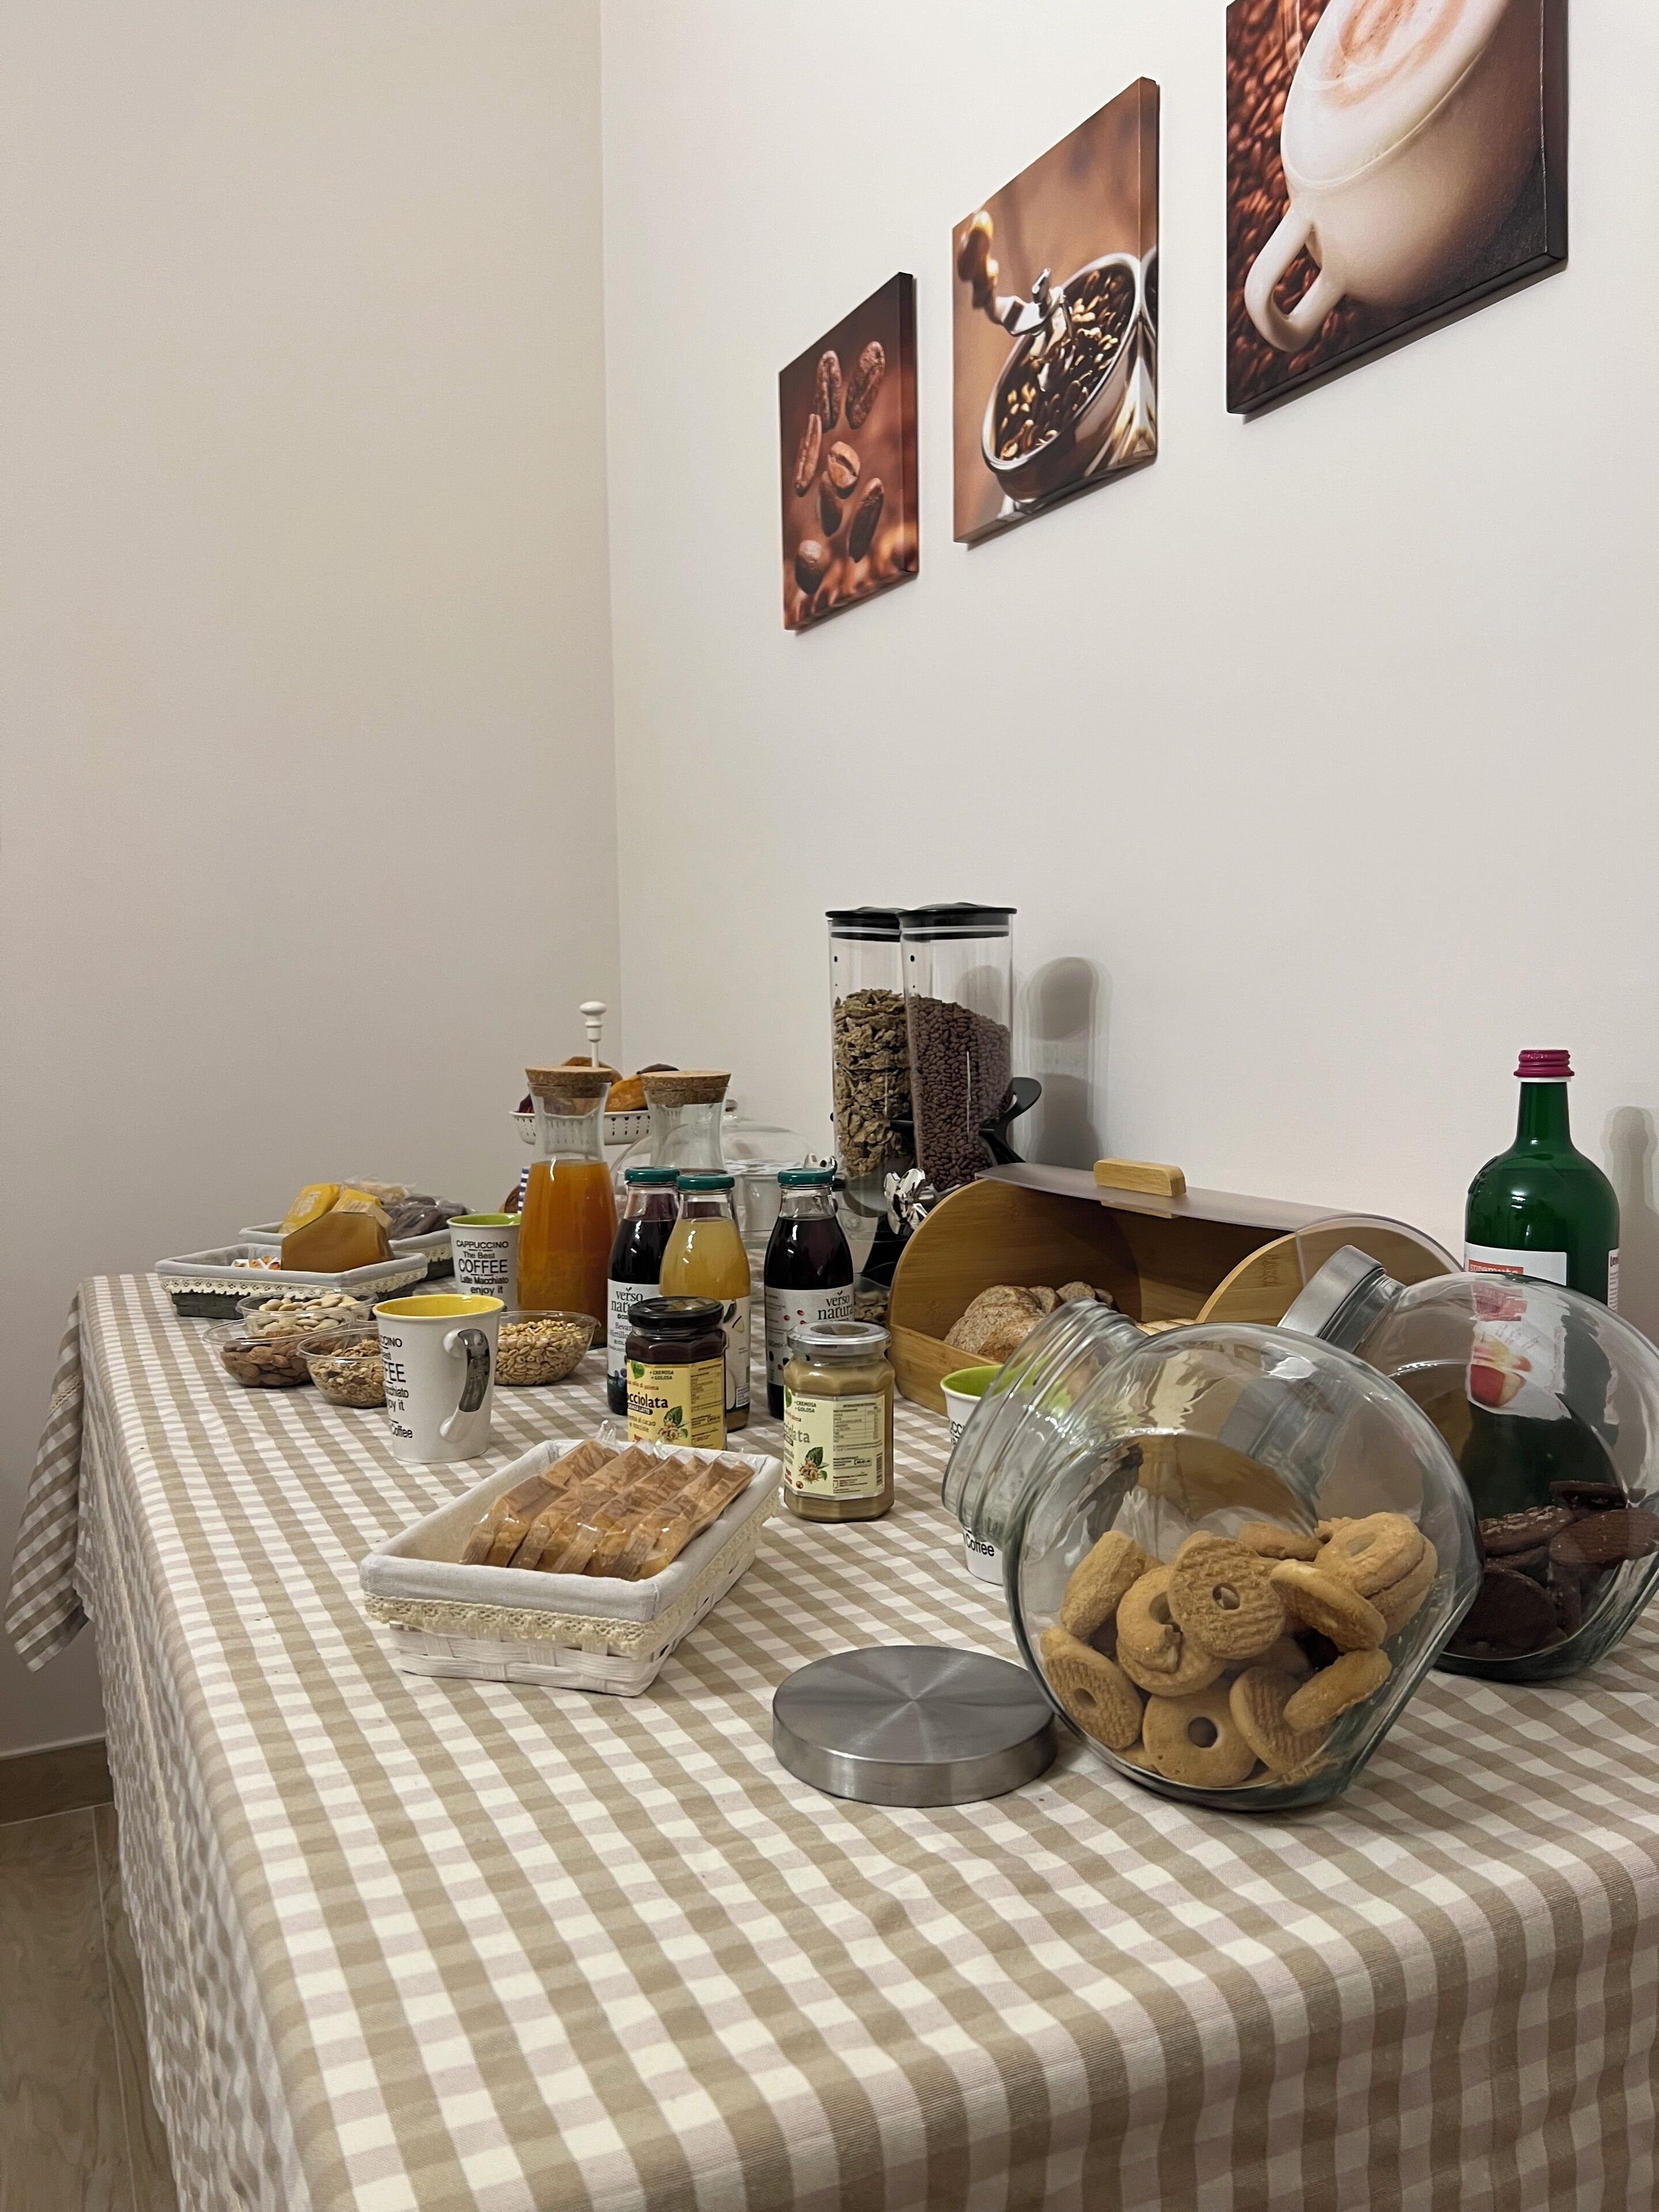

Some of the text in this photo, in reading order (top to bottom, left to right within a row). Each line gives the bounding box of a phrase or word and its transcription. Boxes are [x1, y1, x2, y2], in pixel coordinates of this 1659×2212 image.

[456, 1240, 509, 1249] CAPPUCCINO
[459, 1259, 508, 1274] COFFEE
[471, 1285, 503, 1296] enjoy it
[616, 1291, 643, 1301] verso
[392, 1423, 413, 1438] Coffee
